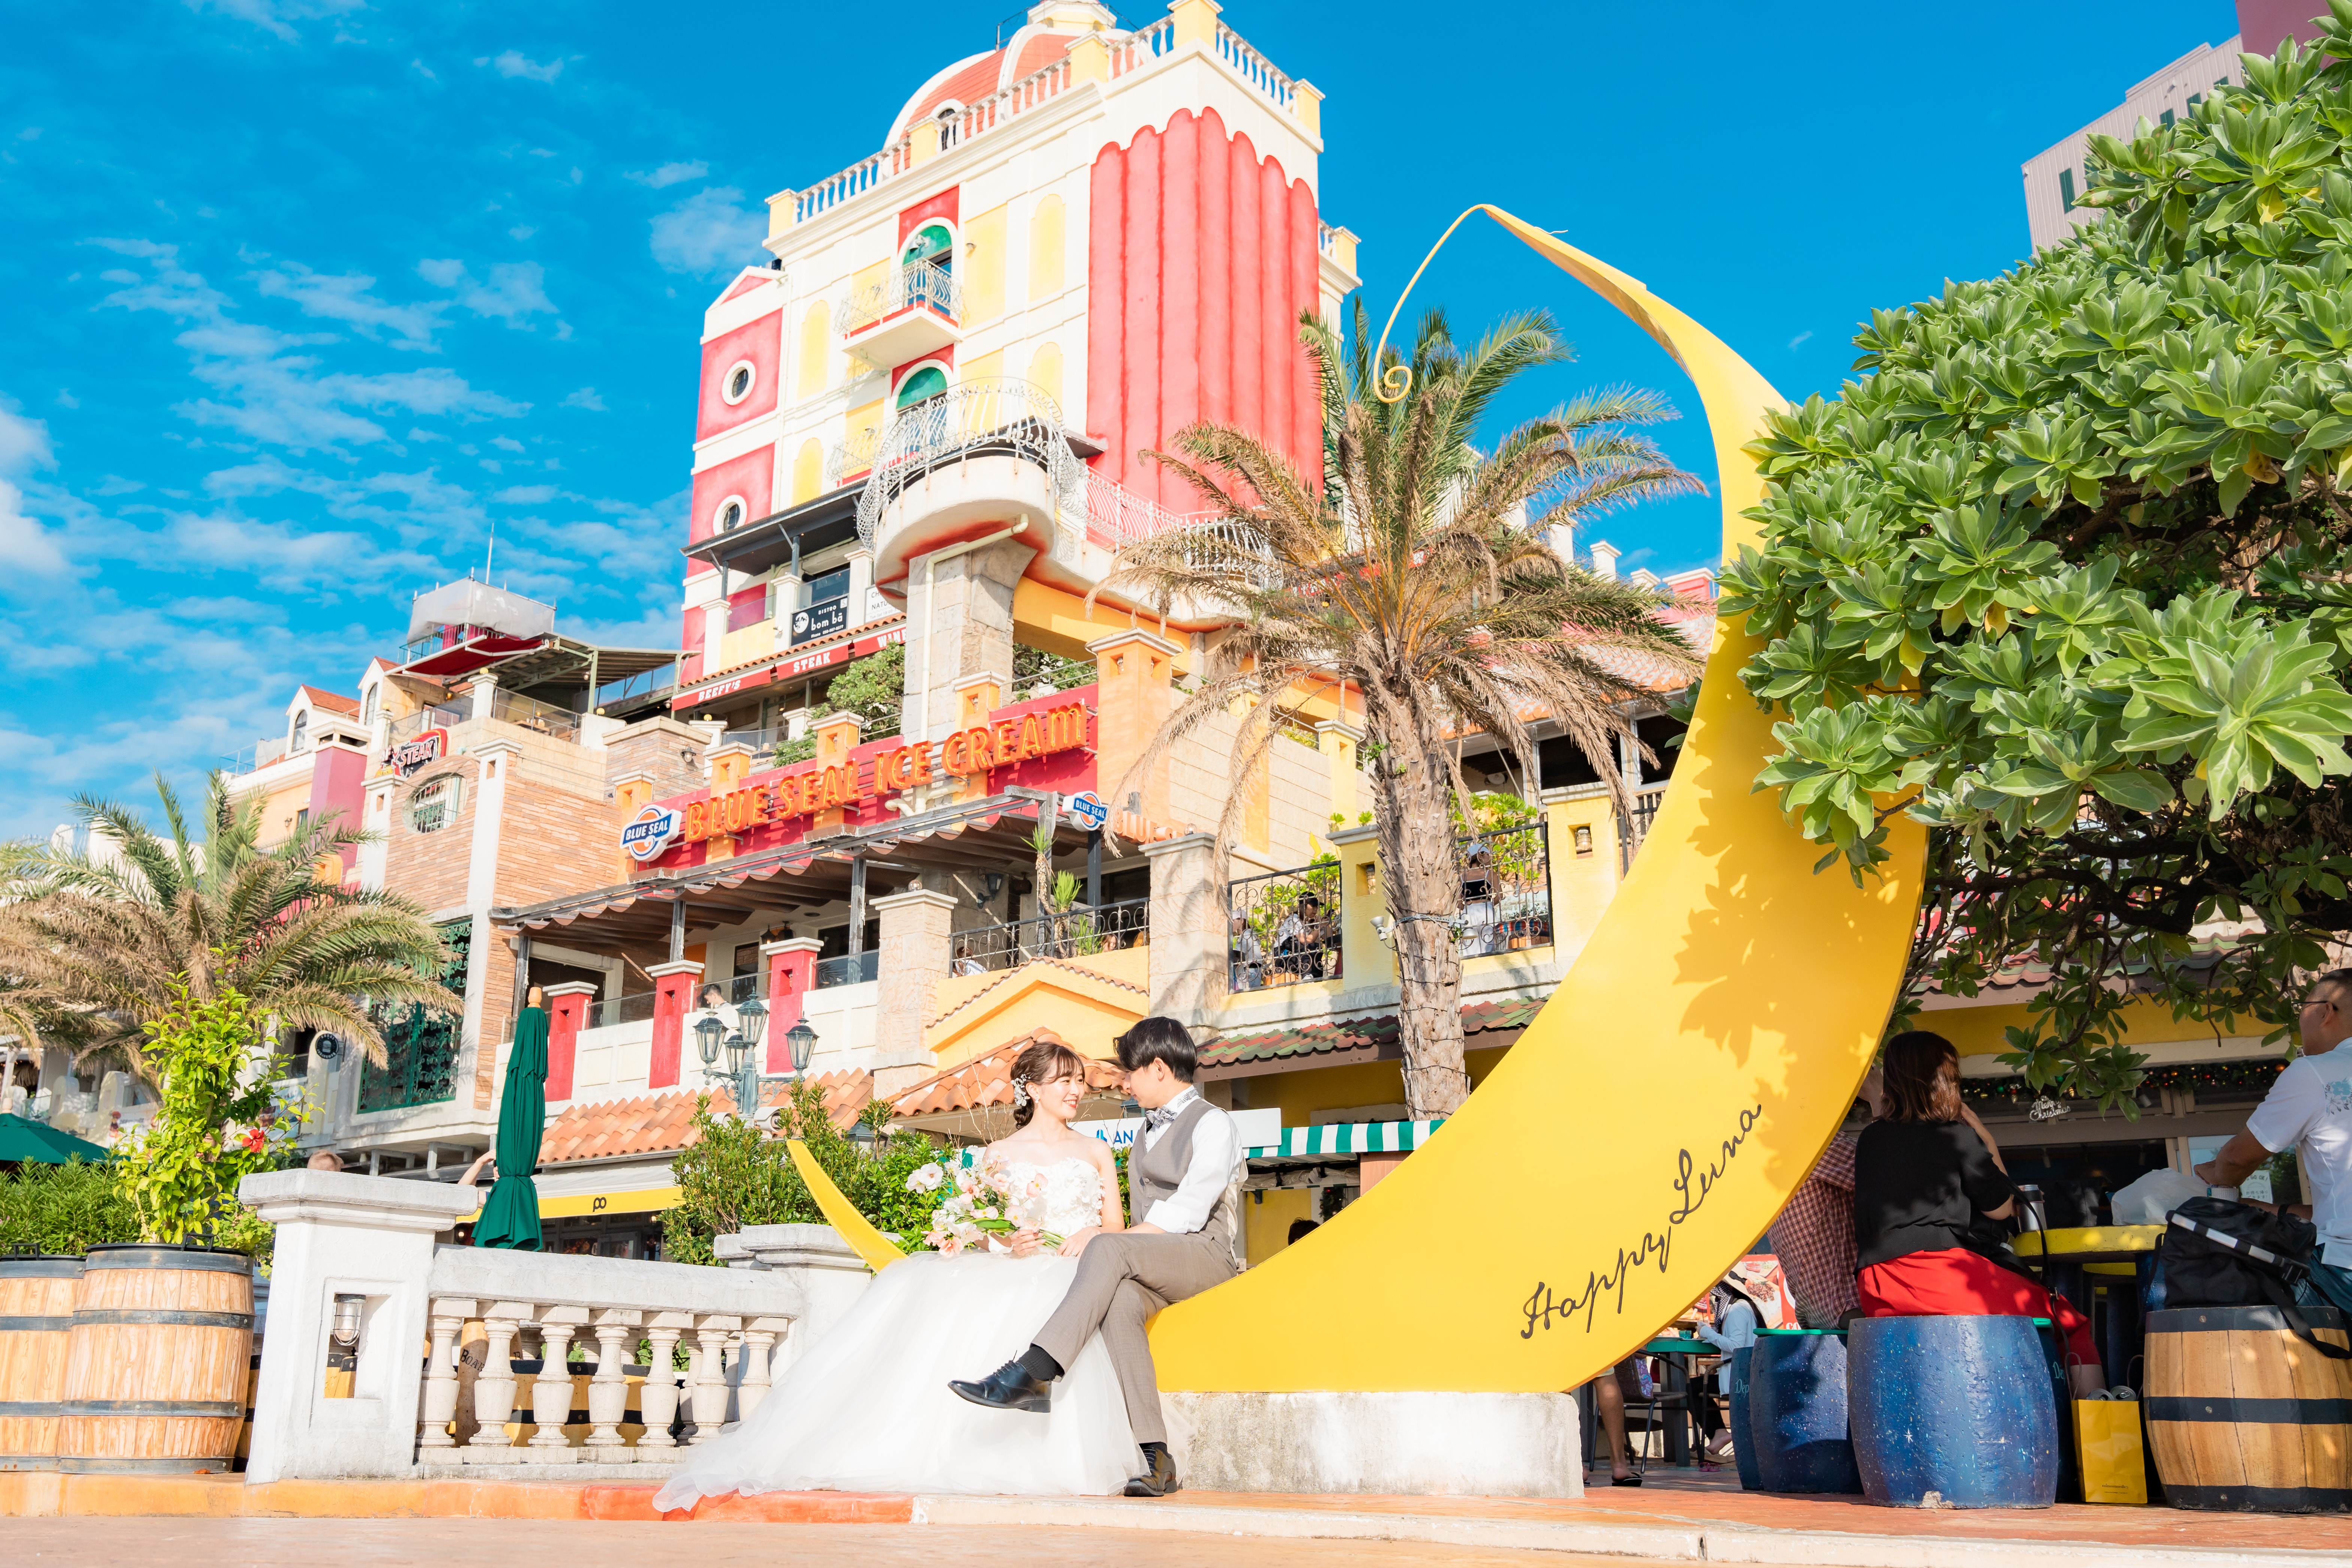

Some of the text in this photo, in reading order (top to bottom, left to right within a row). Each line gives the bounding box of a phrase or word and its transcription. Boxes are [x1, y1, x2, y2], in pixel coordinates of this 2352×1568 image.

[818, 605, 836, 615] BISTRO
[872, 600, 890, 610] NATU
[811, 618, 829, 631] bom
[793, 652, 830, 673] STEAK
[698, 679, 741, 702] BEEFY'S
[400, 740, 433, 767] STEAK
[684, 784, 770, 843] BLUE
[777, 760, 864, 820] SEAL
[873, 740, 934, 796] ICE
[1076, 799, 1105, 818] BLUE SEAL
[626, 820, 668, 841] BLUE SEAL
[1521, 1104, 1761, 1339] Happy Luna
